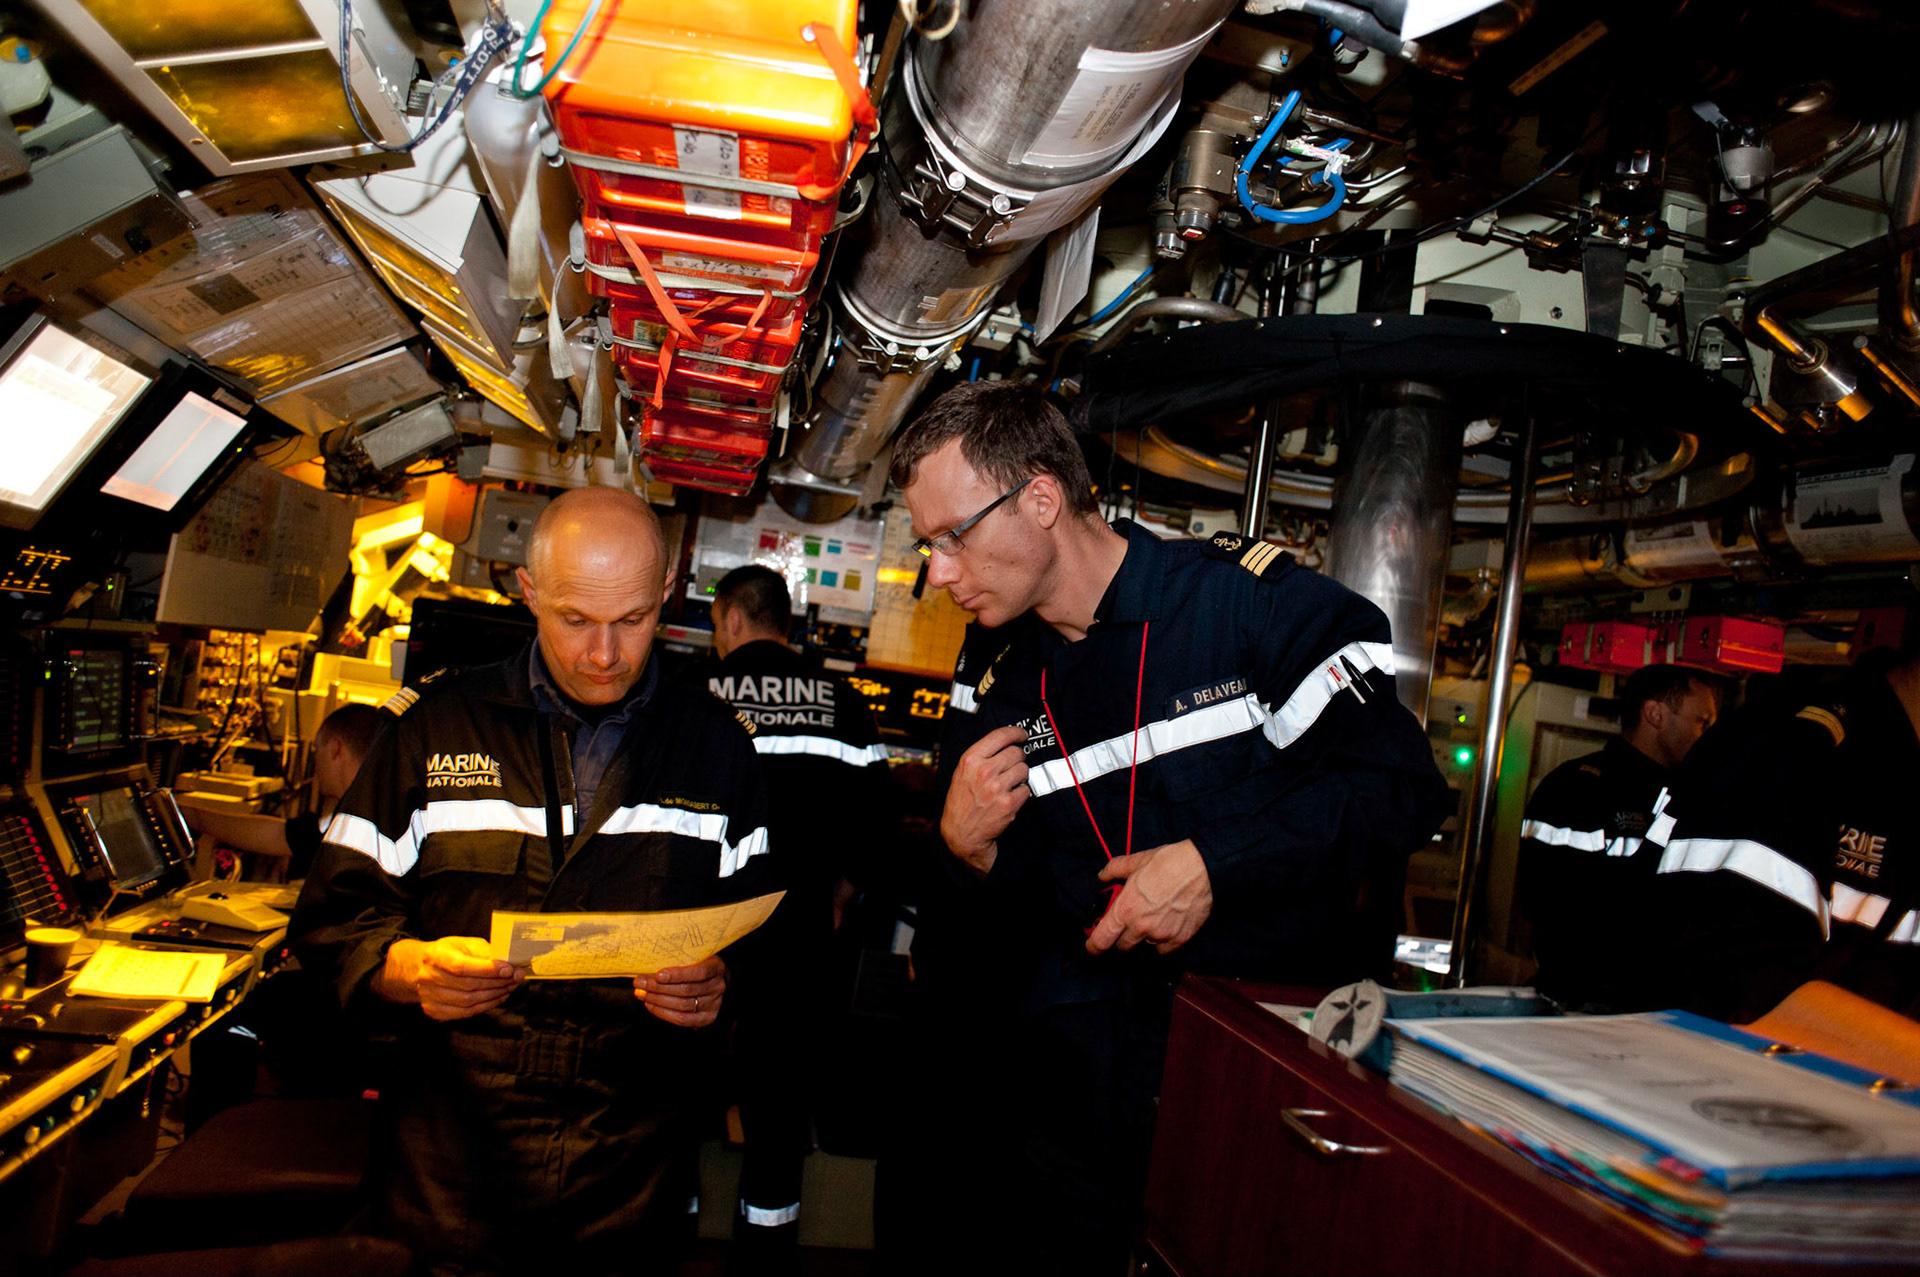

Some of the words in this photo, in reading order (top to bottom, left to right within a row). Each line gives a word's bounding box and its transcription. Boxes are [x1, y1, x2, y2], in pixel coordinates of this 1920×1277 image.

[708, 675, 836, 707] MARINE
[1175, 699, 1188, 714] A.
[741, 709, 836, 728] TIONALE
